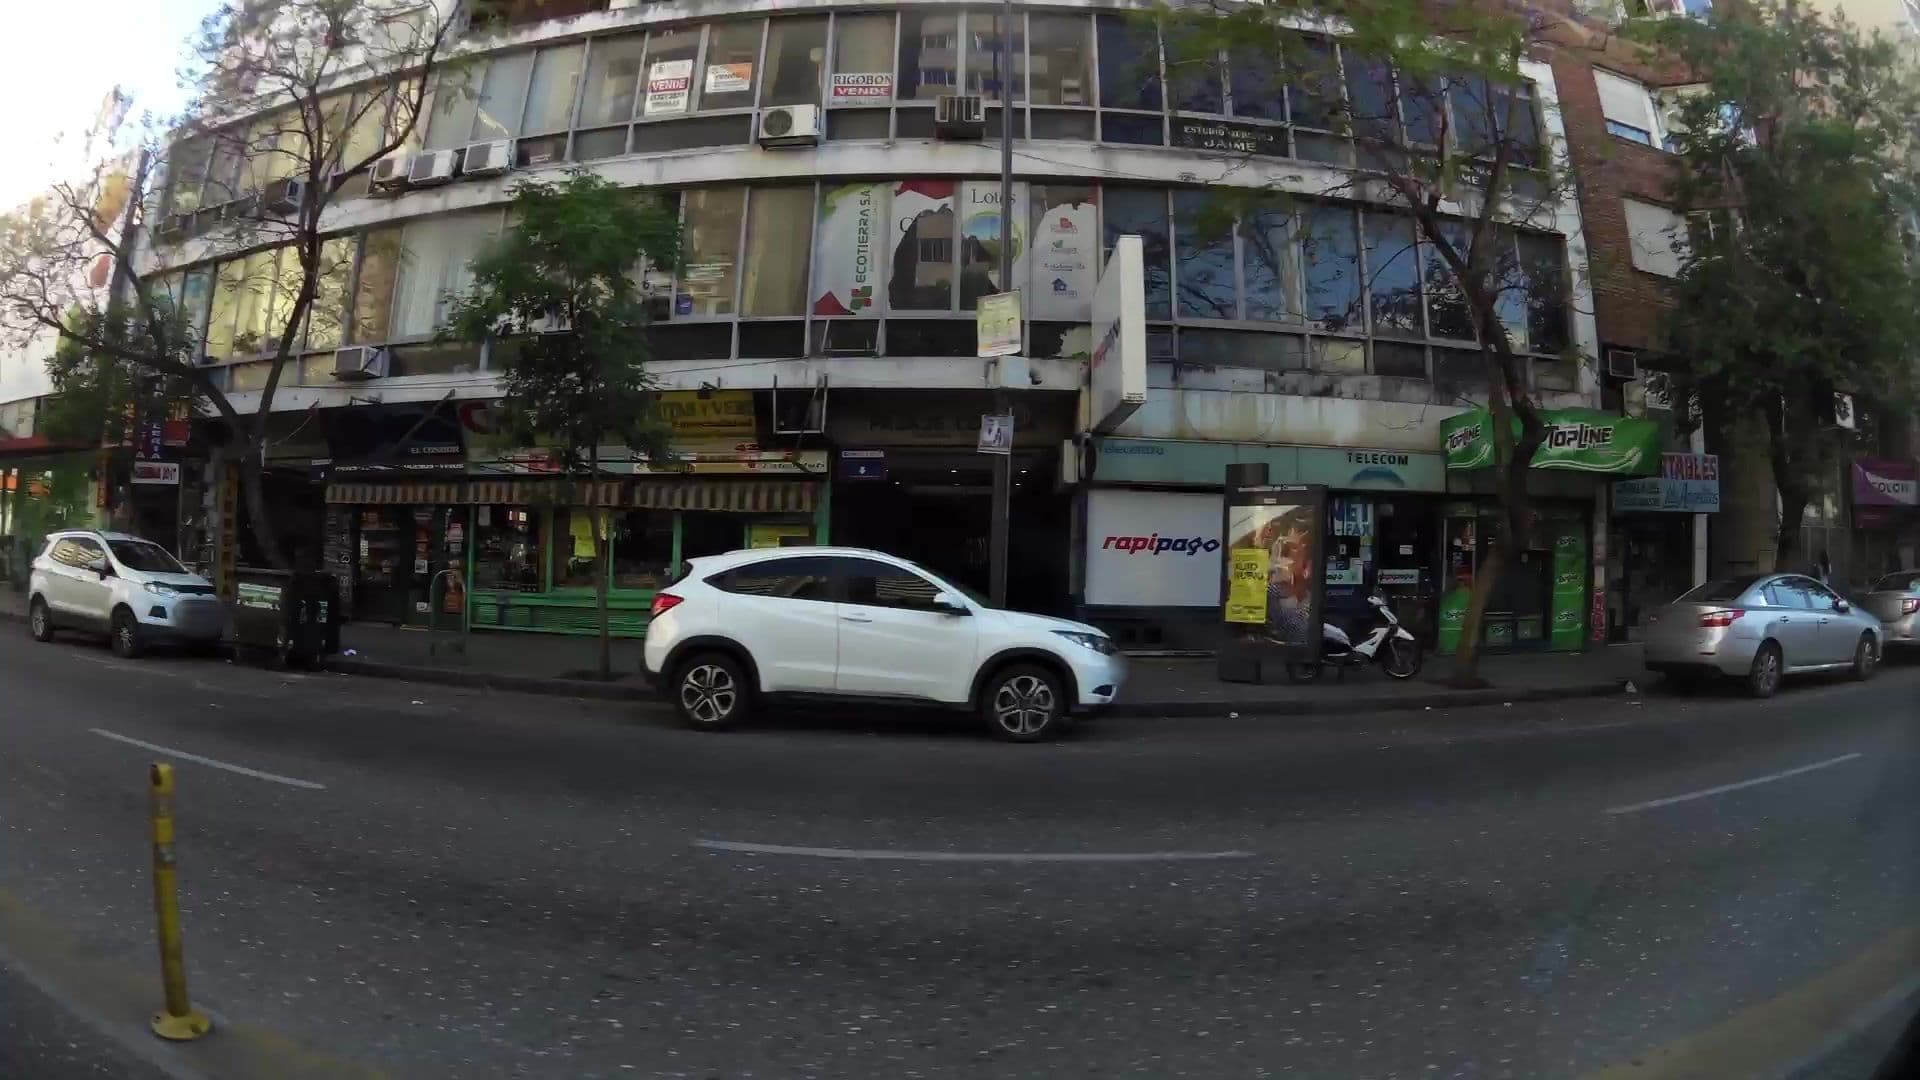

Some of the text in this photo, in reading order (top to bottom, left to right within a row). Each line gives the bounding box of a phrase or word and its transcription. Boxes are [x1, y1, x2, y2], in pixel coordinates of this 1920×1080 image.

[651, 79, 687, 91] VENDE
[837, 87, 889, 96] VENDE
[855, 208, 869, 283] ECOTIERRA
[1346, 452, 1409, 466] TELECOM
[1103, 533, 1221, 556] rapipago
